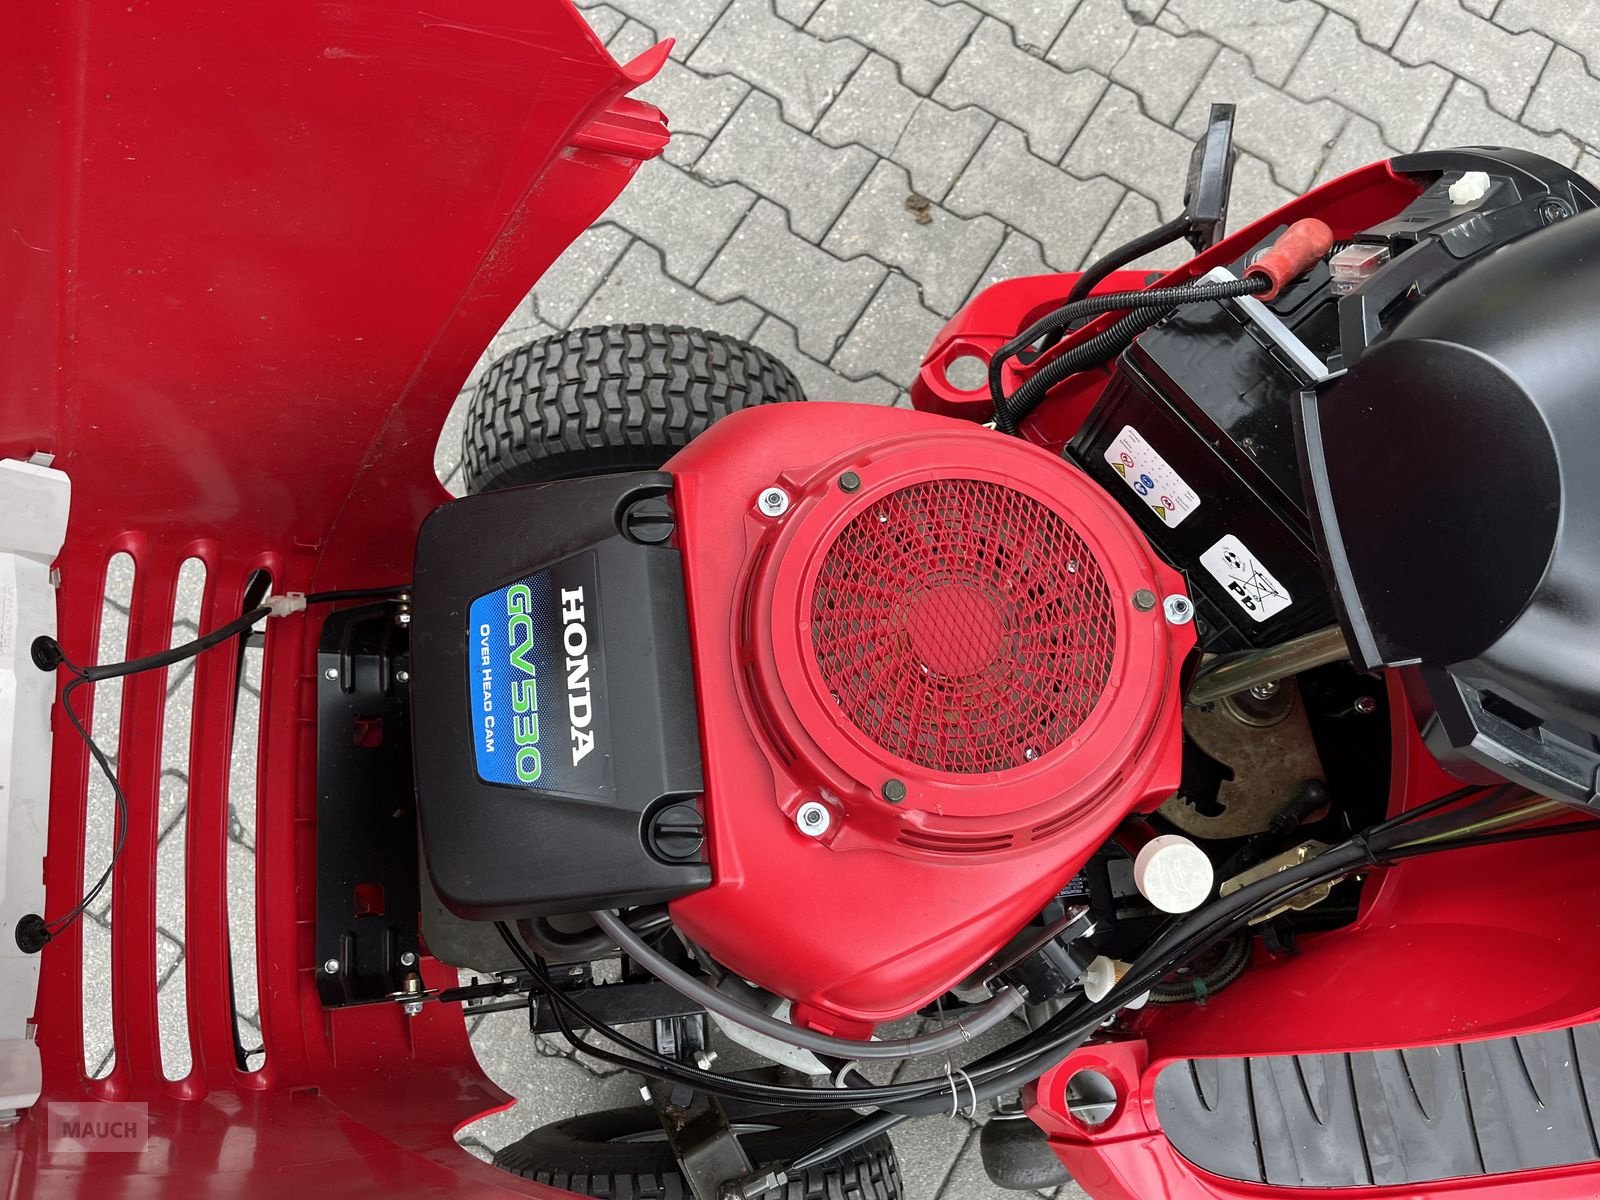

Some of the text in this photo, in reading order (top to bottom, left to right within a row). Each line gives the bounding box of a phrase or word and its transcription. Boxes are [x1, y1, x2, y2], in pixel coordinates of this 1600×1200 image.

[1228, 581, 1256, 611] Pb
[480, 624, 494, 752] OVER HEAD CAM
[507, 584, 542, 782] GCV530
[561, 586, 595, 766] HONDA
